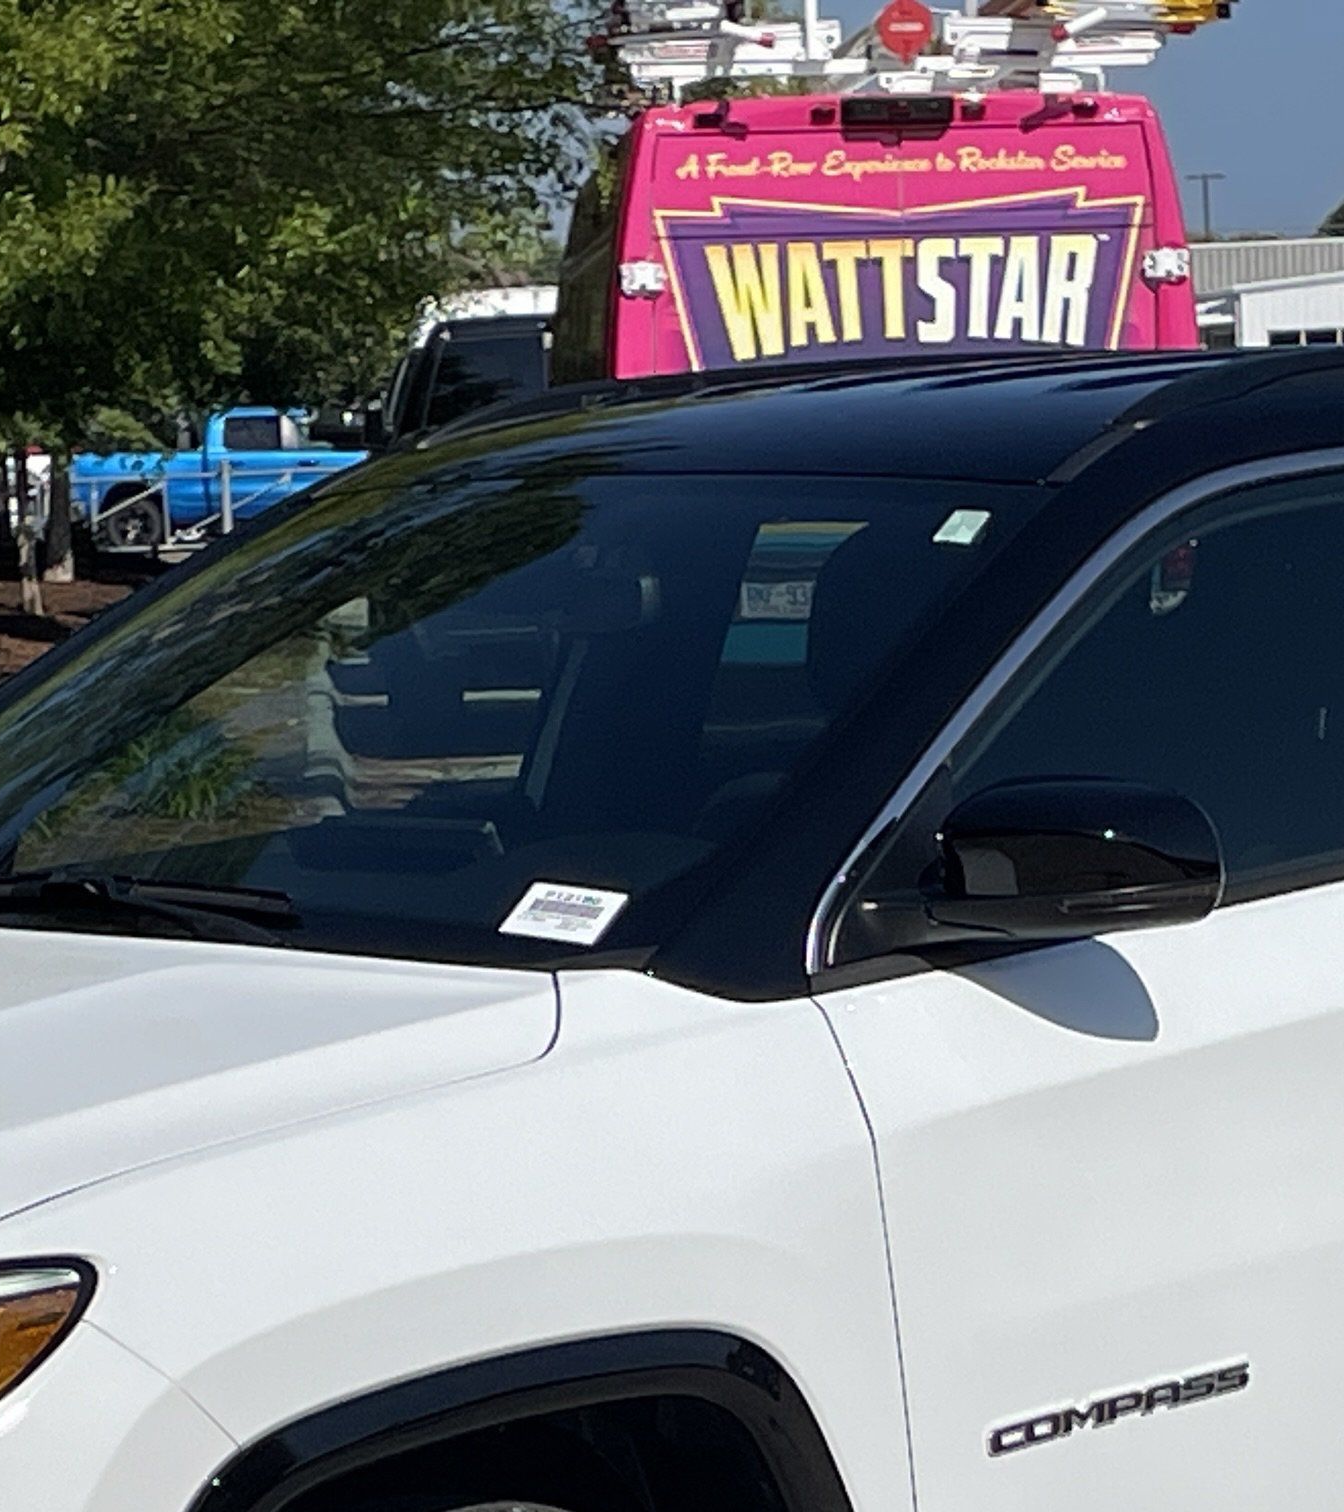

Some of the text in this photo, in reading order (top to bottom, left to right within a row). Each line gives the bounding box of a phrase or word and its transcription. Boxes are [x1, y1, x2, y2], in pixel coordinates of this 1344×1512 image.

[675, 153, 700, 180] A
[821, 149, 933, 182] Experience
[934, 151, 956, 172] to
[956, 146, 1047, 172] Rockstar
[1049, 144, 1128, 171] Service
[703, 233, 1098, 361] WATTSTAR
[987, 1357, 1250, 1458] COMPASS
